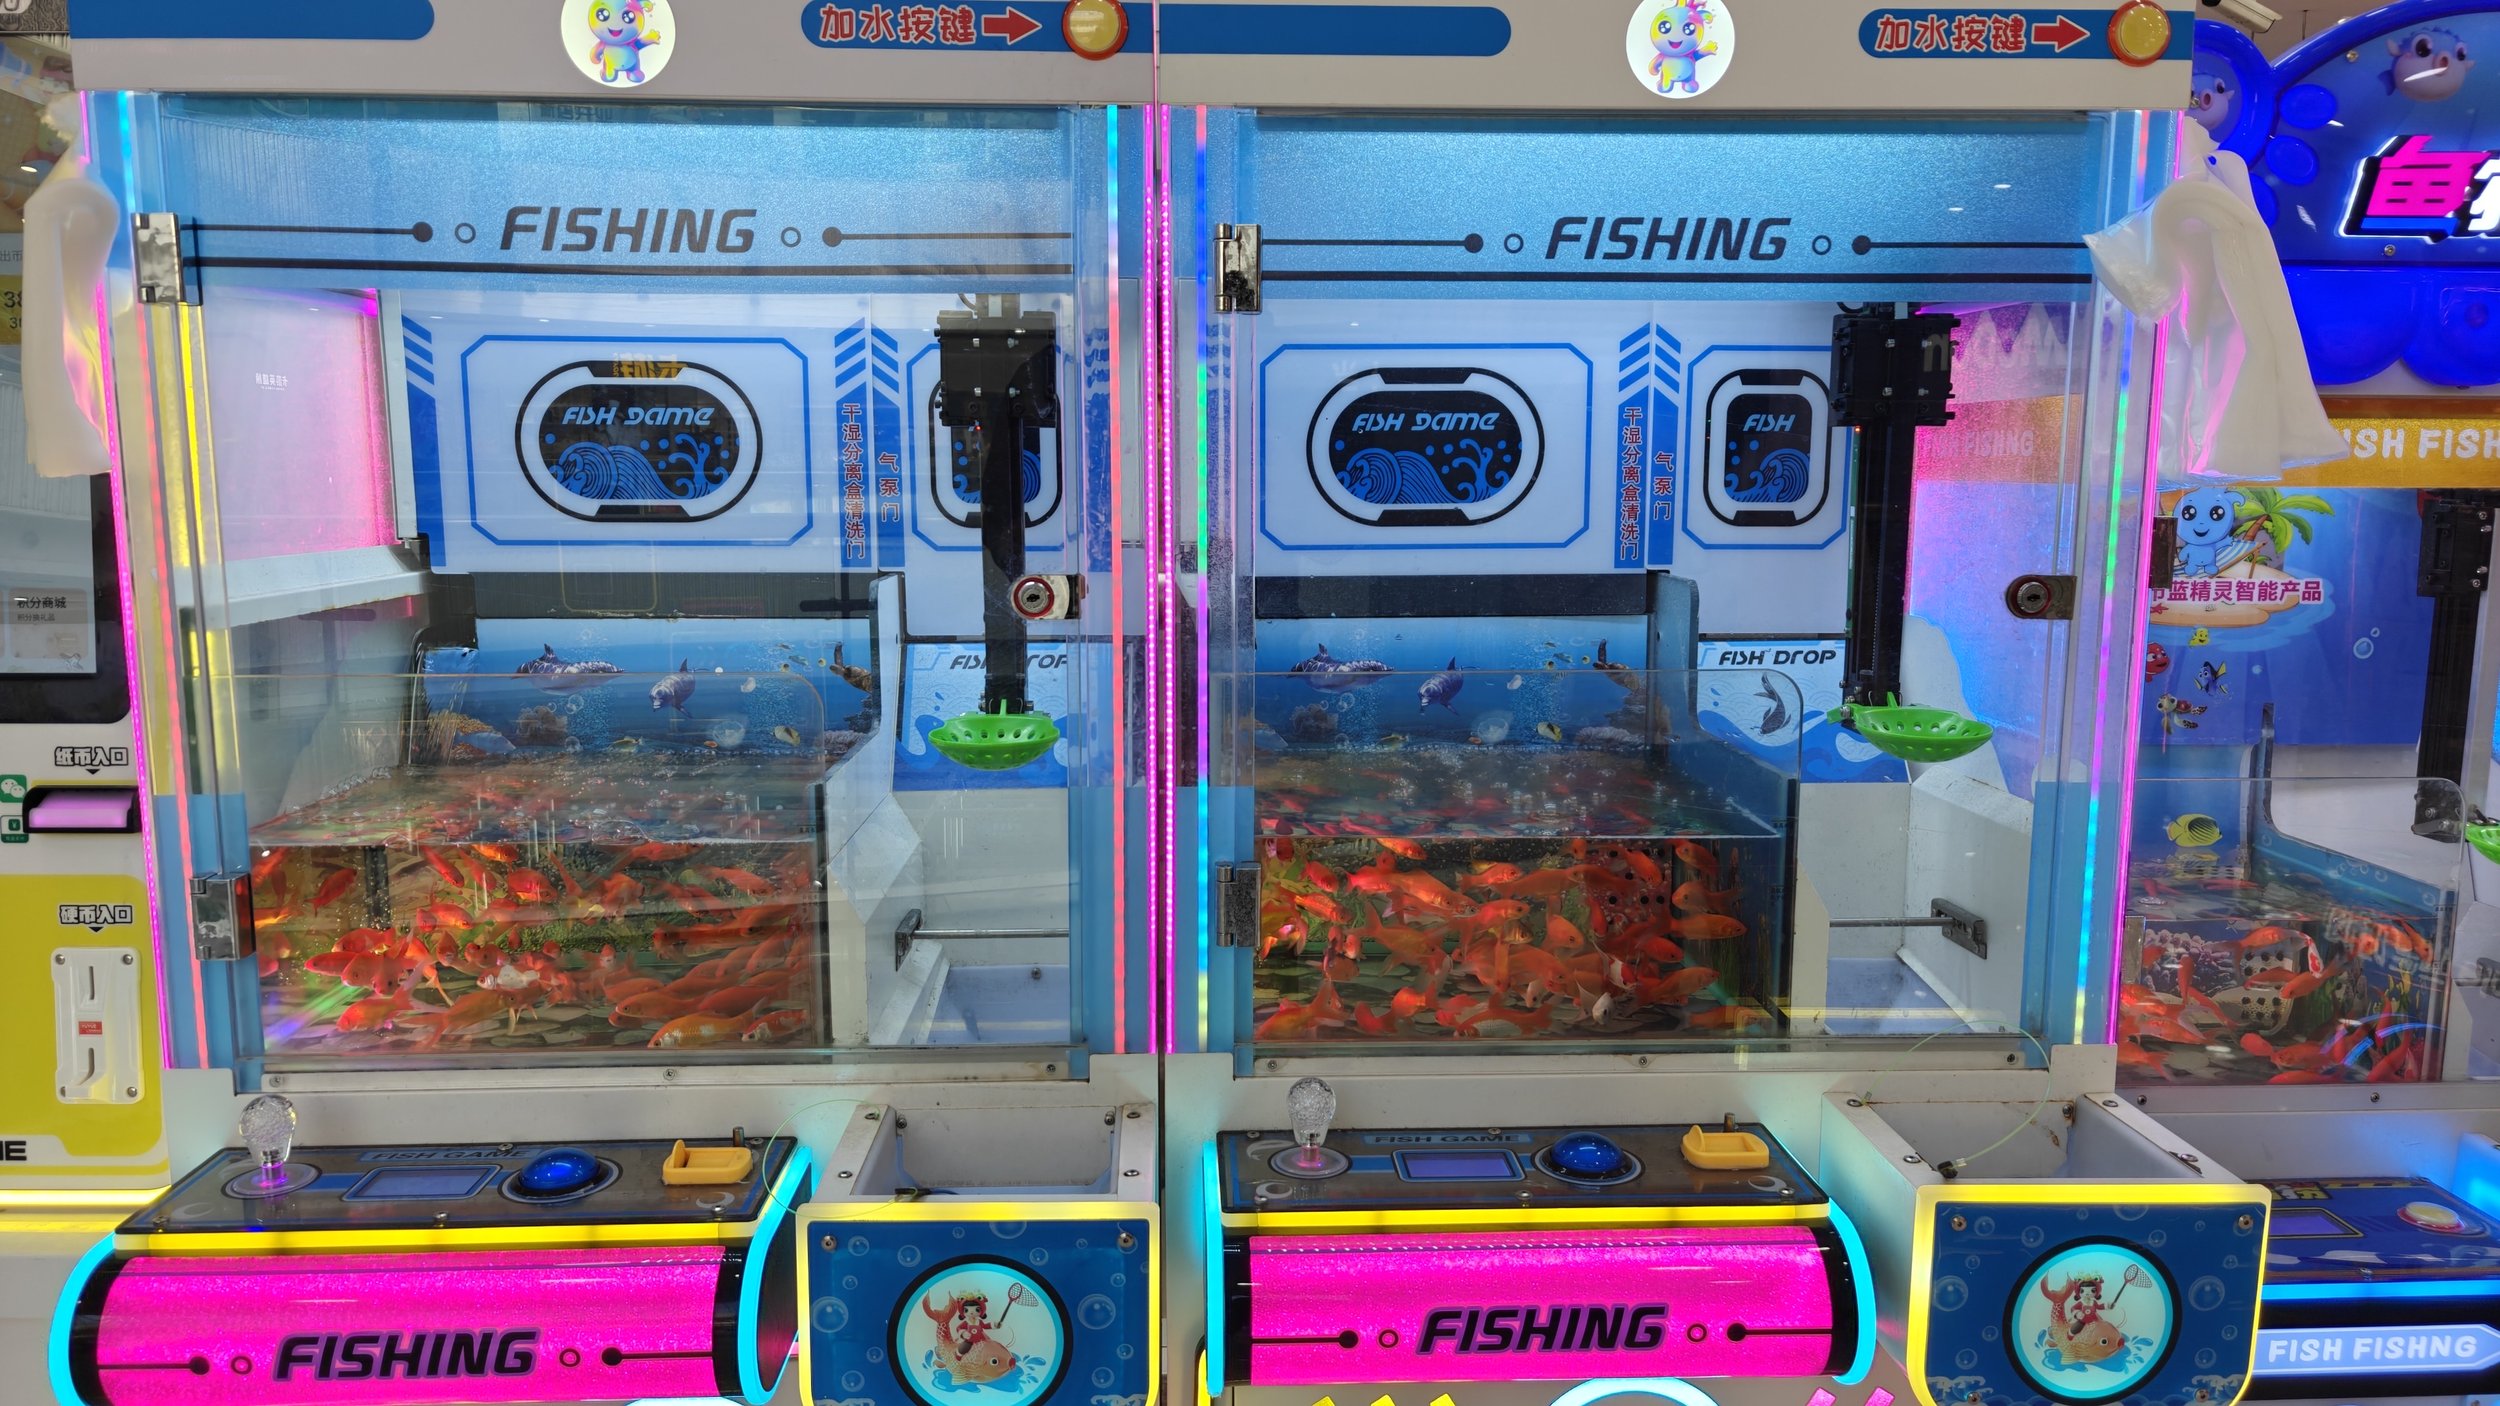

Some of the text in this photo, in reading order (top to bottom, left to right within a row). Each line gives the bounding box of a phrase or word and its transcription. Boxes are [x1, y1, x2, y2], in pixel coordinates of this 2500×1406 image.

[819, 4, 976, 45] 加水按键
[1875, 14, 2026, 53] 加水按键
[2361, 135, 2500, 235] 鱼
[500, 205, 756, 253] FISHING
[1545, 217, 1792, 260] FISHING
[562, 406, 618, 425] FISH
[1352, 413, 1405, 431] FISH
[1743, 414, 1795, 432] FISH
[842, 403, 866, 559] 干湿分离盒清洗门
[879, 453, 900, 522] 气泵门
[1620, 407, 1643, 560] 干湿分离盒清洗门
[1653, 452, 1674, 520] 气泵门
[17, 596, 67, 609] 积分商城
[1719, 650, 1764, 665] FISH
[54, 746, 129, 766] 纸币入口
[59, 904, 133, 924] 硬币入口
[371, 1151, 436, 1160] FISH
[1440, 1135, 1520, 1143] GAME
[1417, 1304, 1668, 1354] FISHING
[274, 1329, 540, 1381] FISHING
[2268, 1335, 2478, 1363] FISH FISHNG
